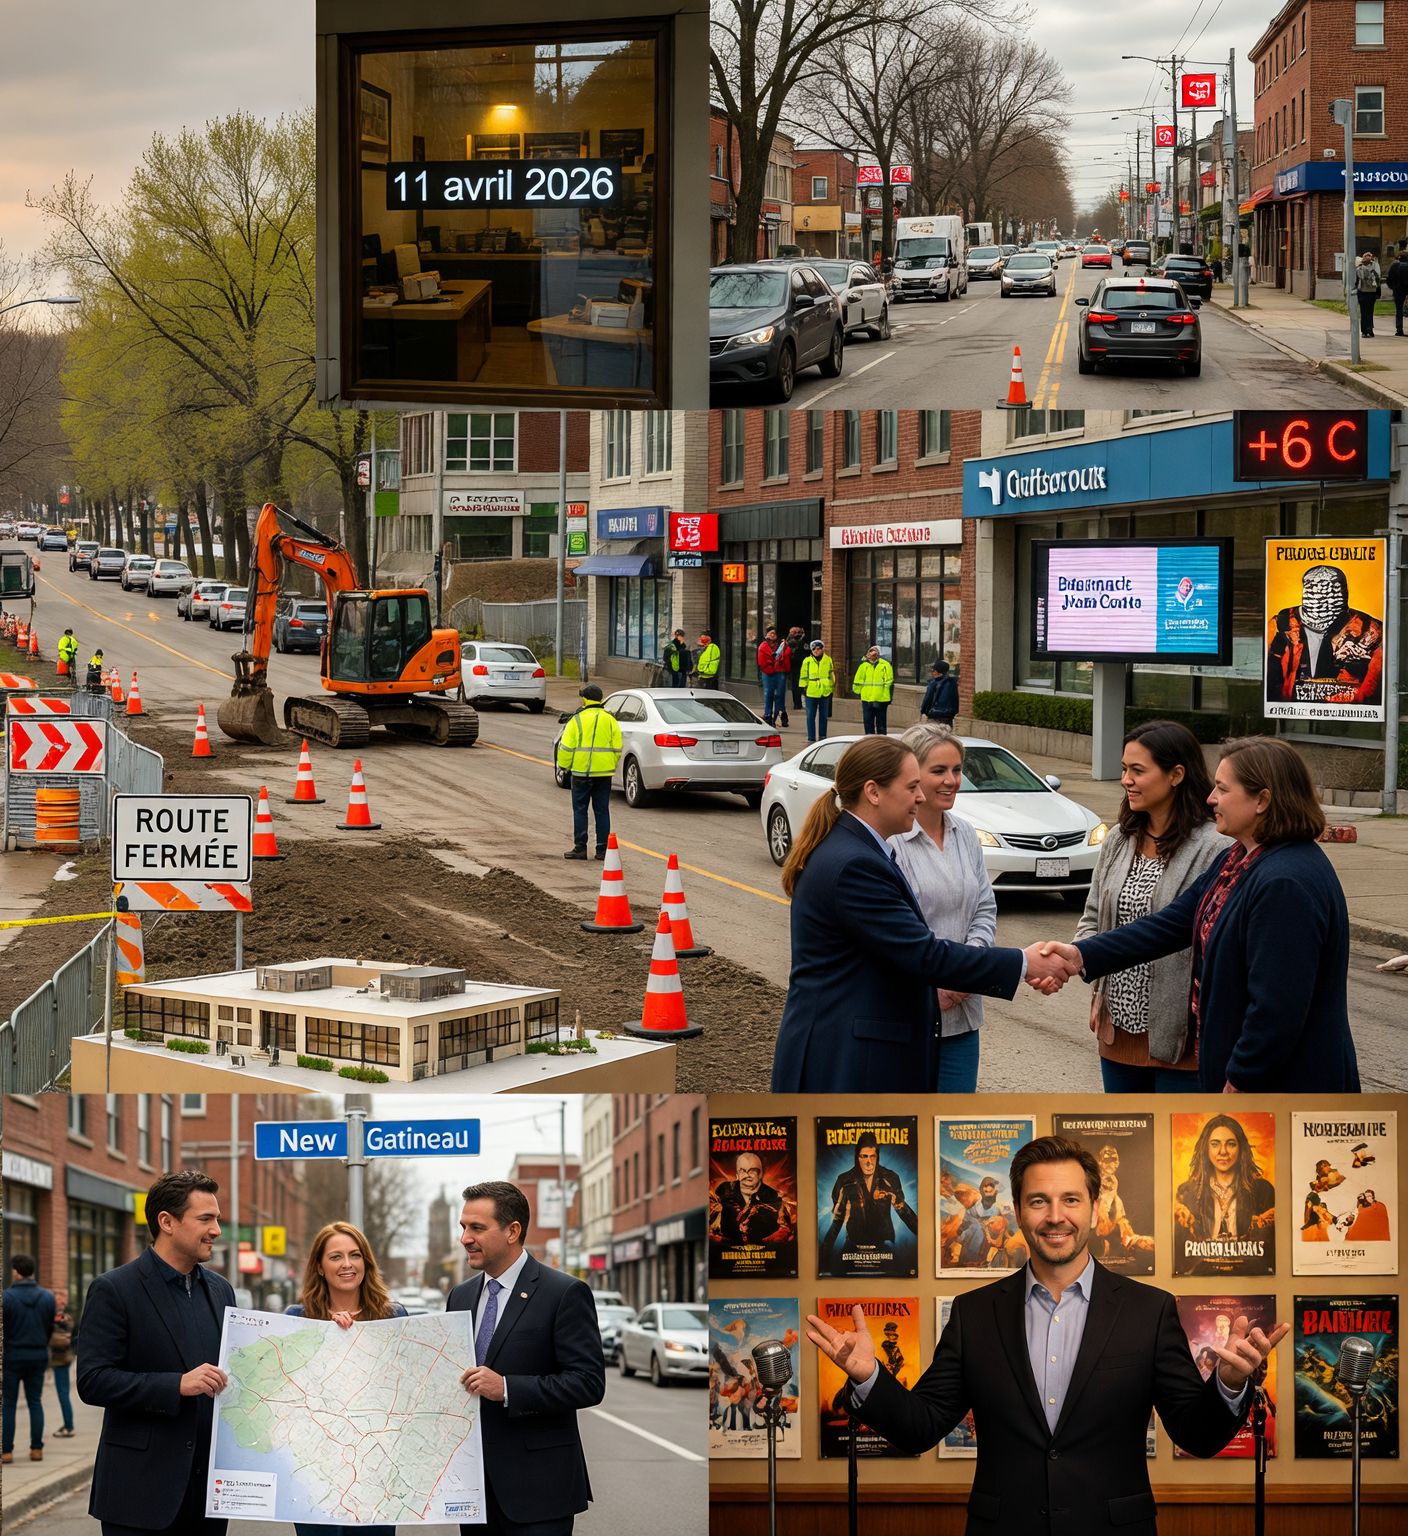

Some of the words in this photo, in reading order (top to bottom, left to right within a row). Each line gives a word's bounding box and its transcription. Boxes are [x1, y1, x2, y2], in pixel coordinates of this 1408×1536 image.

[393, 170, 429, 202] 11
[443, 168, 513, 202] avril
[525, 166, 614, 201] 2026
[1248, 419, 1312, 469] +6
[1327, 420, 1357, 462] C
[136, 808, 229, 834] ROUTE
[125, 837, 238, 869] FERMÉE
[279, 1128, 337, 1153] New
[367, 1126, 469, 1151] Gatineau
